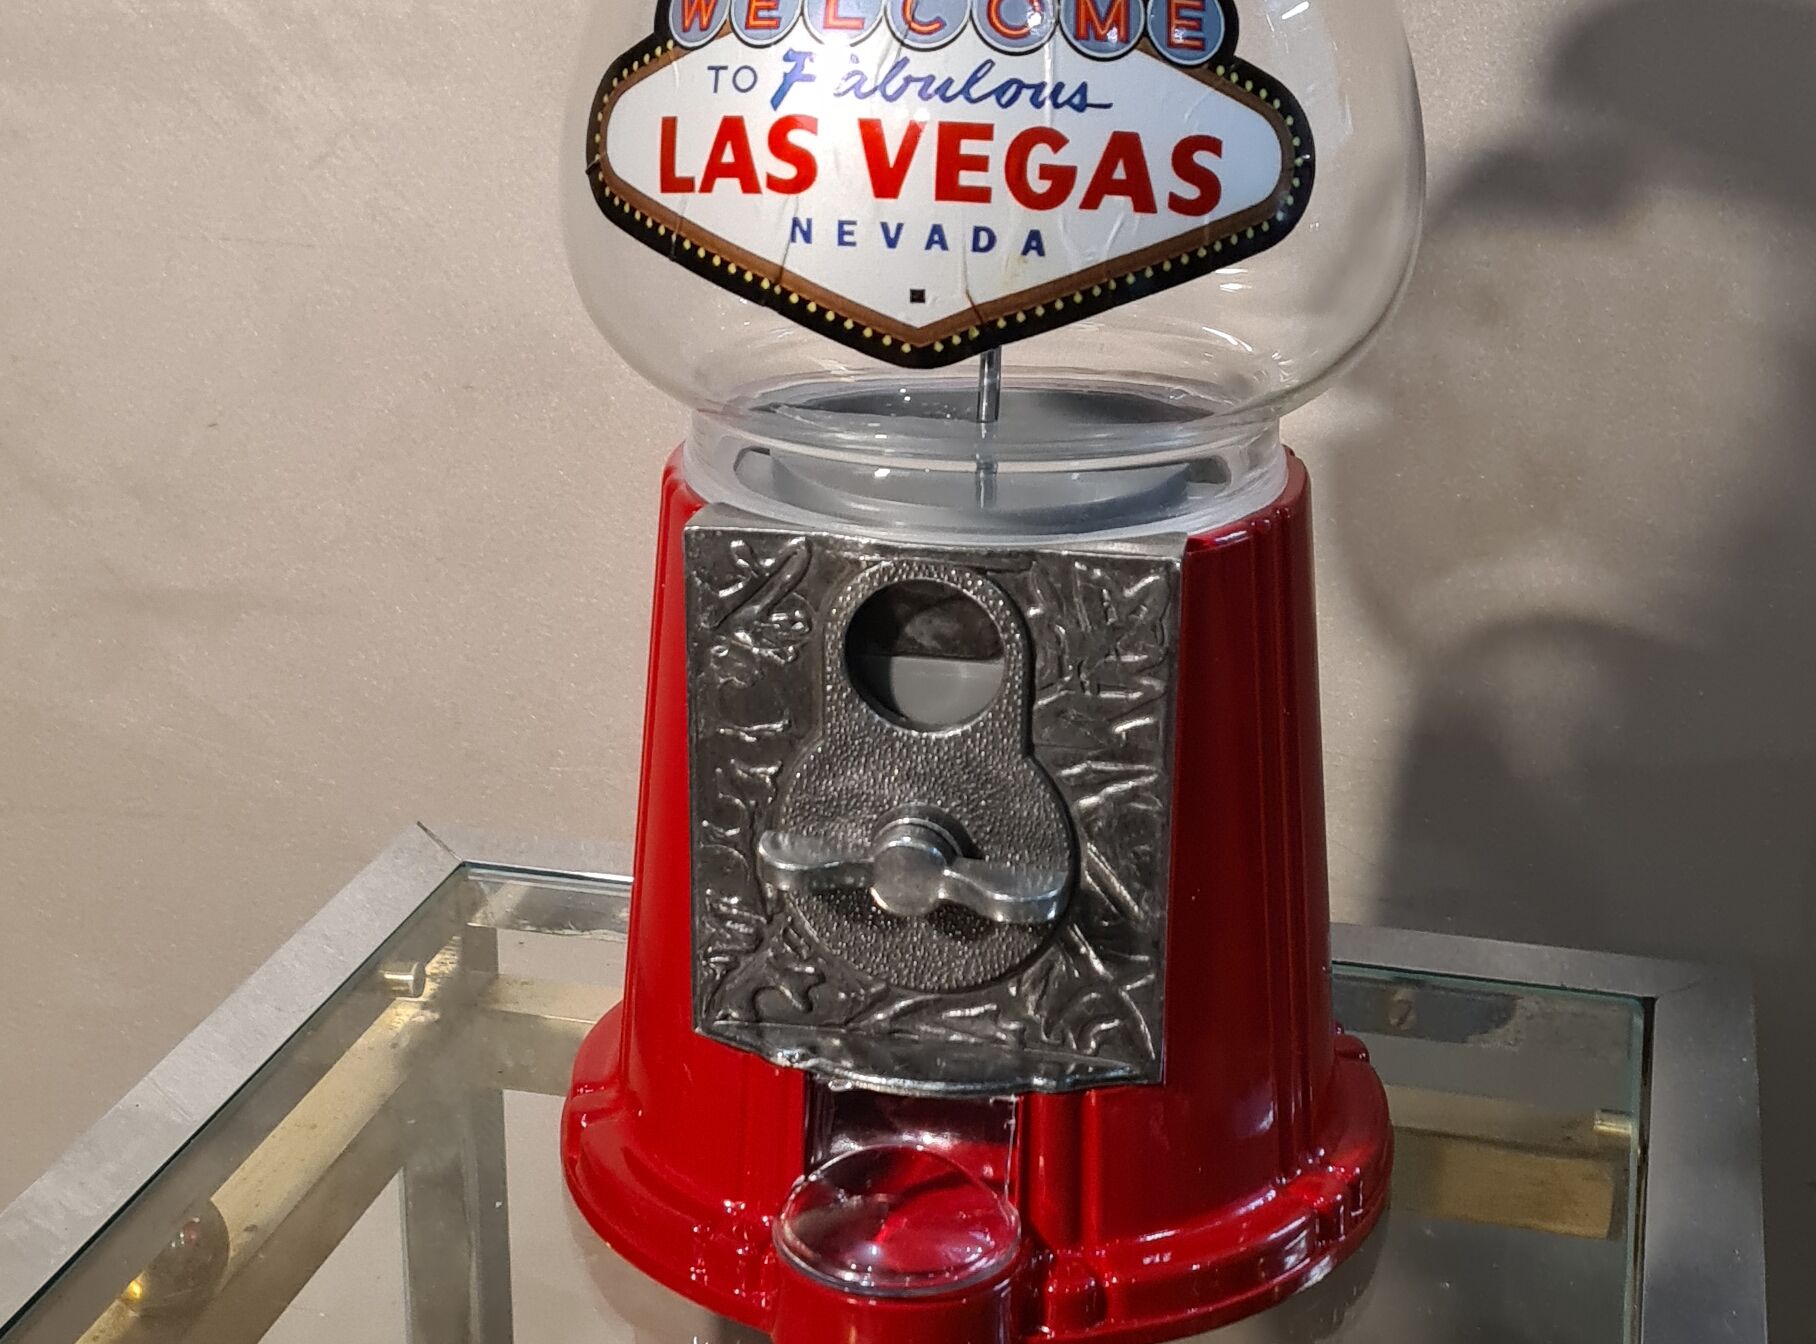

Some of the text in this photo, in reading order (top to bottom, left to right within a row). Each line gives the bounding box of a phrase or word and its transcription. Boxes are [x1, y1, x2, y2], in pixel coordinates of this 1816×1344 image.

[707, 47, 1113, 113] TO Fabulous
[659, 114, 1224, 217] LAS VEGAS
[790, 216, 1046, 257] NEVADA
